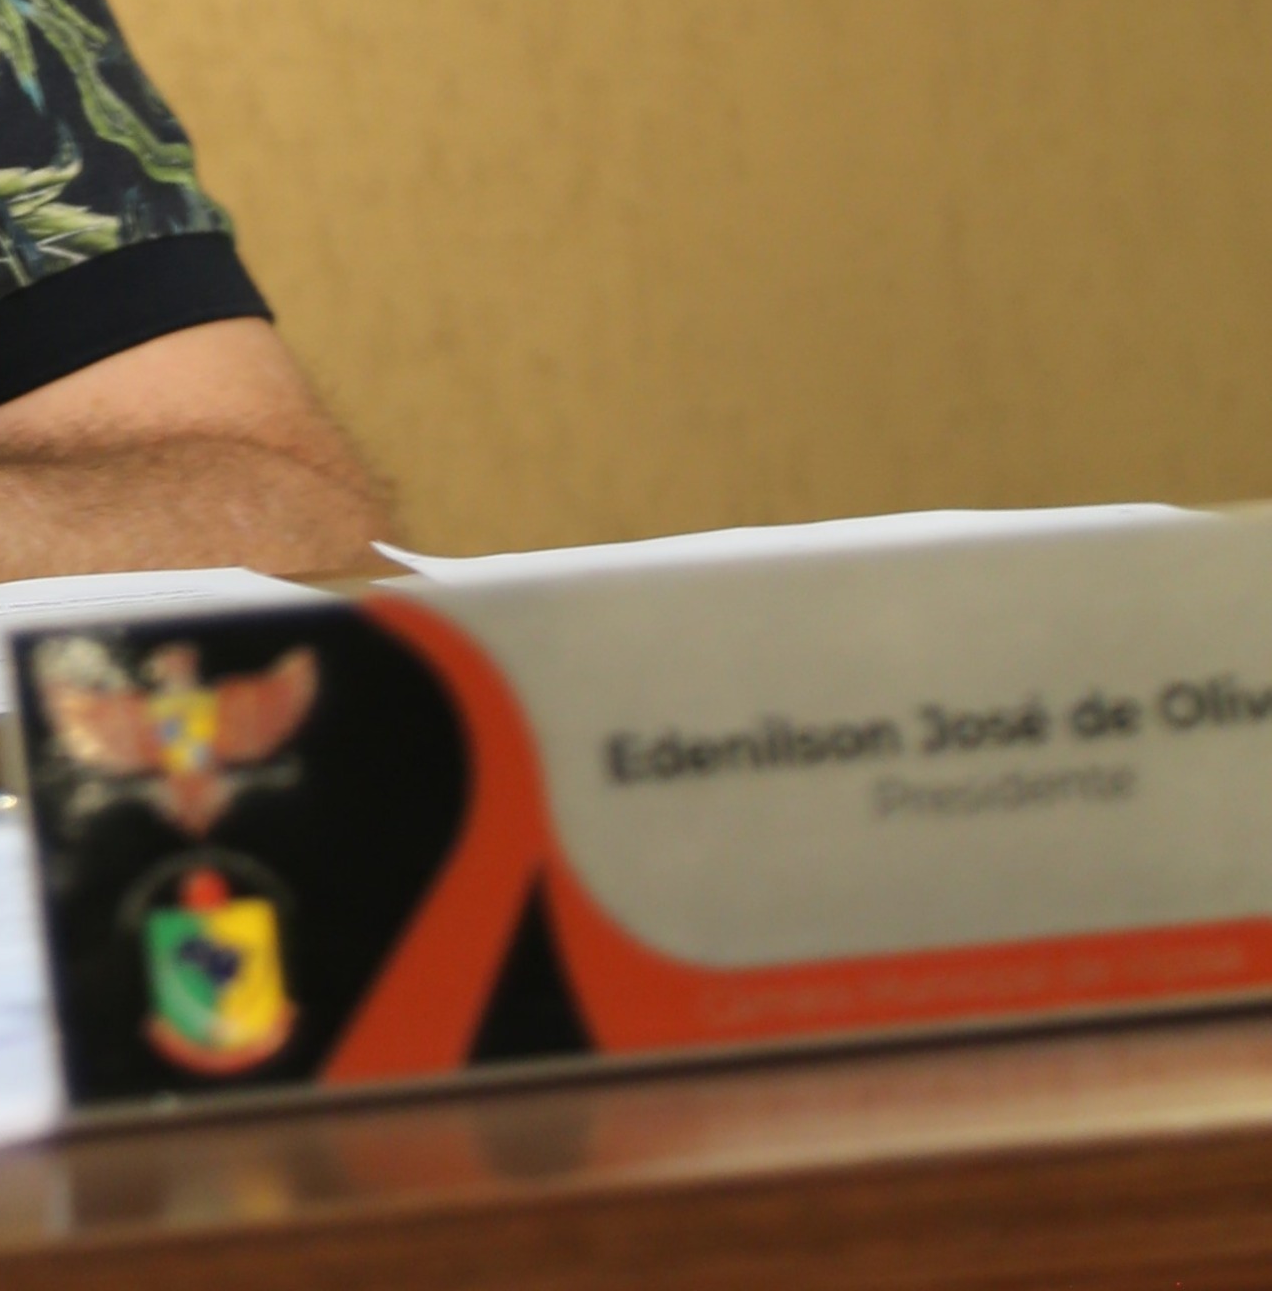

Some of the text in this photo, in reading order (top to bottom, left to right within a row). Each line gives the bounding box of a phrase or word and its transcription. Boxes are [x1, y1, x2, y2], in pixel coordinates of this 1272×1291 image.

[605, 713, 901, 785] Edenilson
[917, 687, 1049, 755] José
[1072, 686, 1144, 740] de
[871, 761, 1135, 820] Presidente
